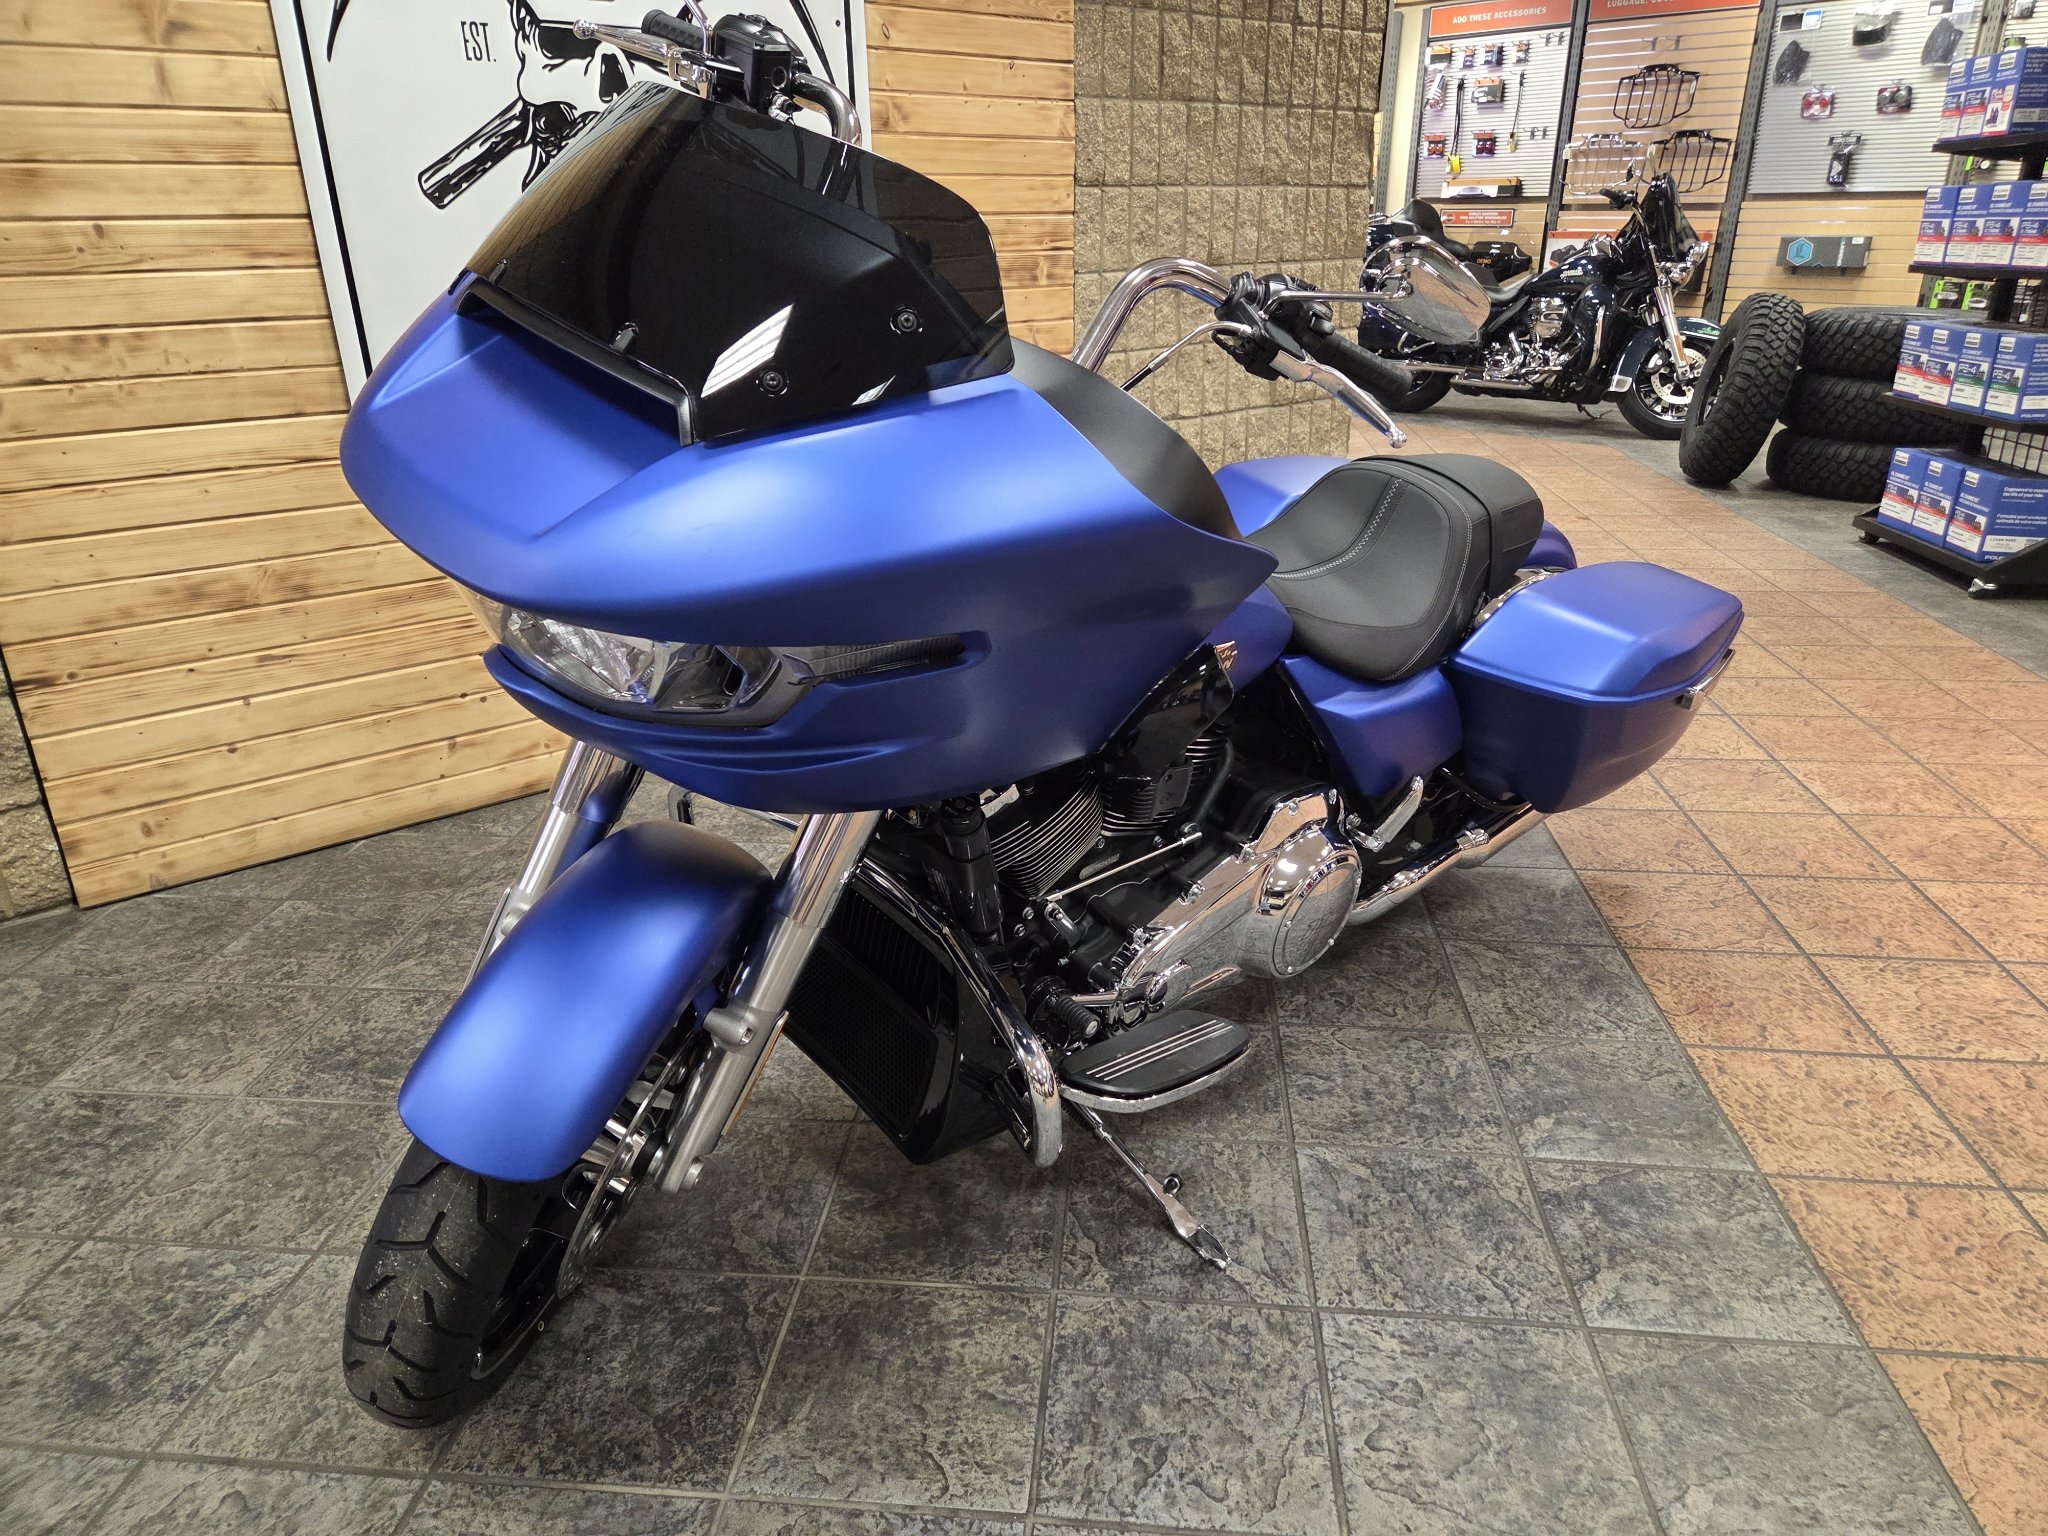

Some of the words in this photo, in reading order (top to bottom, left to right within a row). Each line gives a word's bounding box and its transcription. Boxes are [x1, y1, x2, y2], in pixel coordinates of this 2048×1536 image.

[1452, 16, 1467, 24] ADD
[1469, 13, 1492, 22] THESE
[1494, 6, 1547, 20] ACCESSORIES
[460, 21, 496, 62] EST.
[1958, 363, 1976, 374] PS-4
[1993, 369, 2011, 380] PS-4
